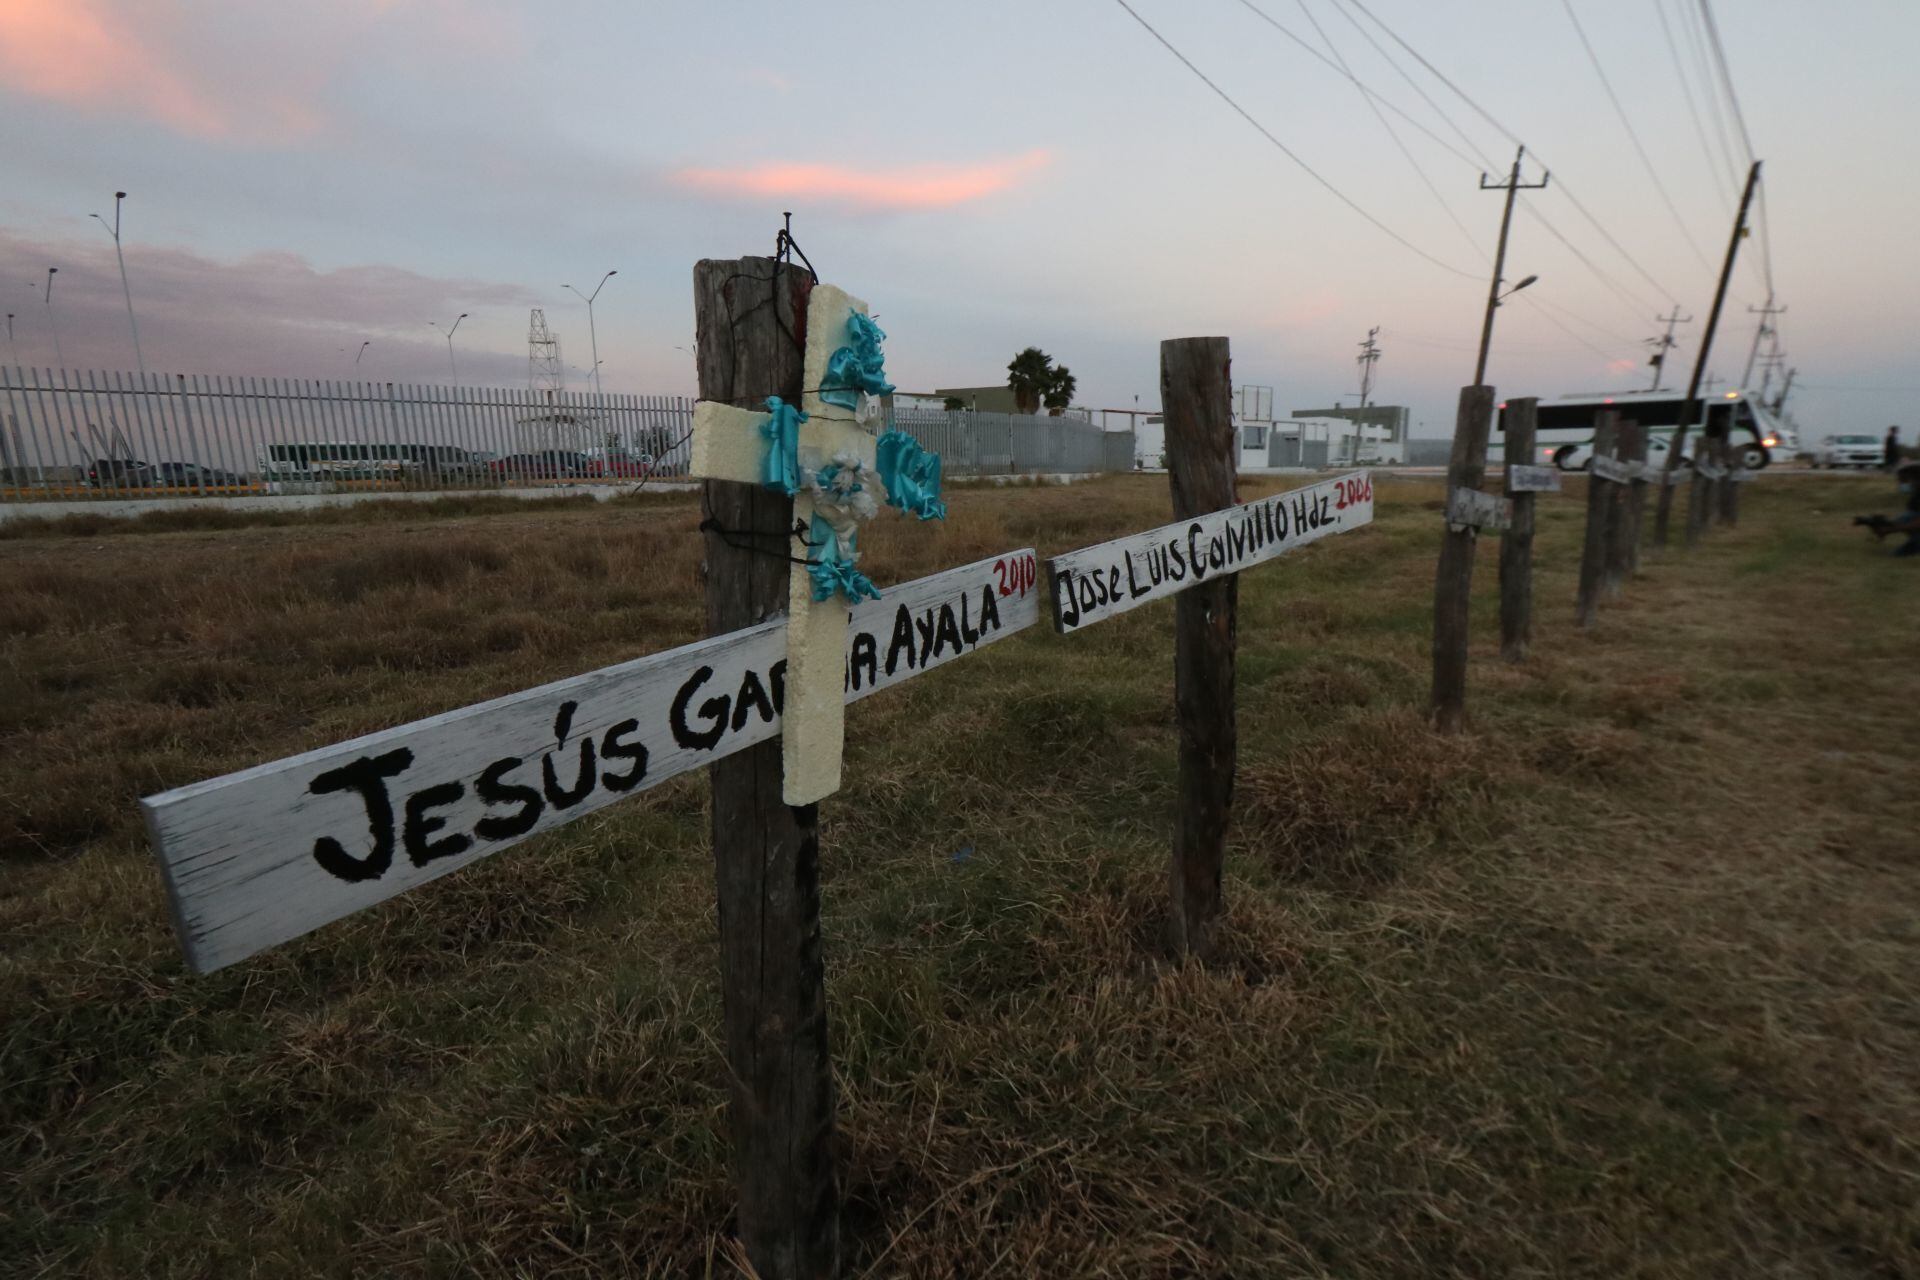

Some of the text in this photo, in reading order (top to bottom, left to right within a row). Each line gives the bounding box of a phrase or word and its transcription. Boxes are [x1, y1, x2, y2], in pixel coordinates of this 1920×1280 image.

[885, 583, 1001, 677] AYALA
[993, 553, 1036, 599] 2010
[1056, 564, 1124, 627] Jose
[1334, 474, 1372, 510] 2006
